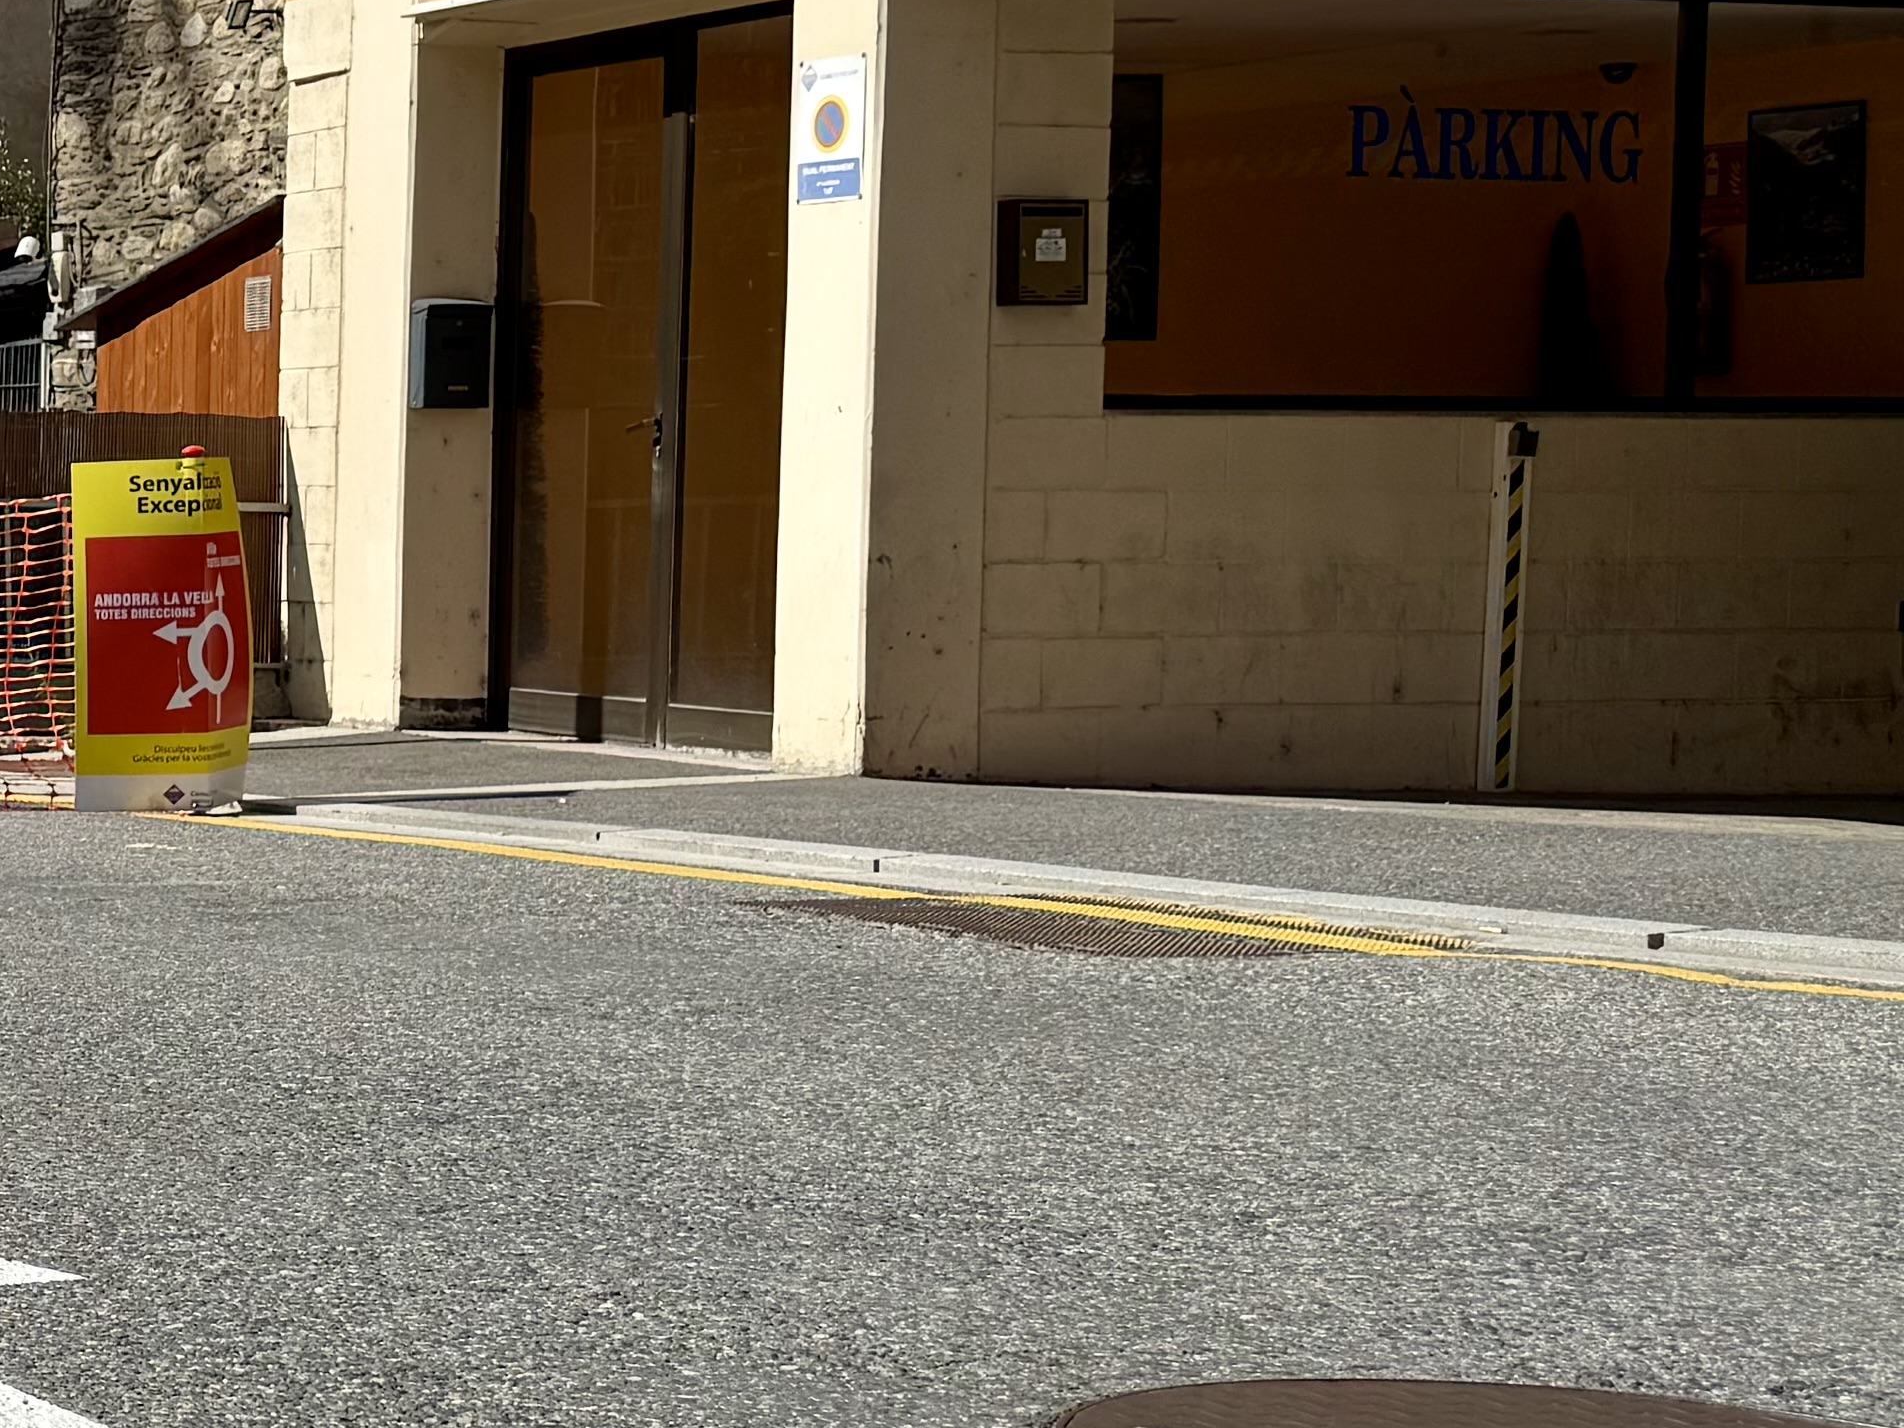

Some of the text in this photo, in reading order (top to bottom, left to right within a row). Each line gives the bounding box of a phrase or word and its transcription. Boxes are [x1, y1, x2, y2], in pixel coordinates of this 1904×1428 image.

[1346, 85, 1643, 184] PÀRKING
[94, 592, 160, 607] ANDORRA
[163, 592, 180, 605] LA
[94, 606, 196, 620] TOTES DIRECCIONS
